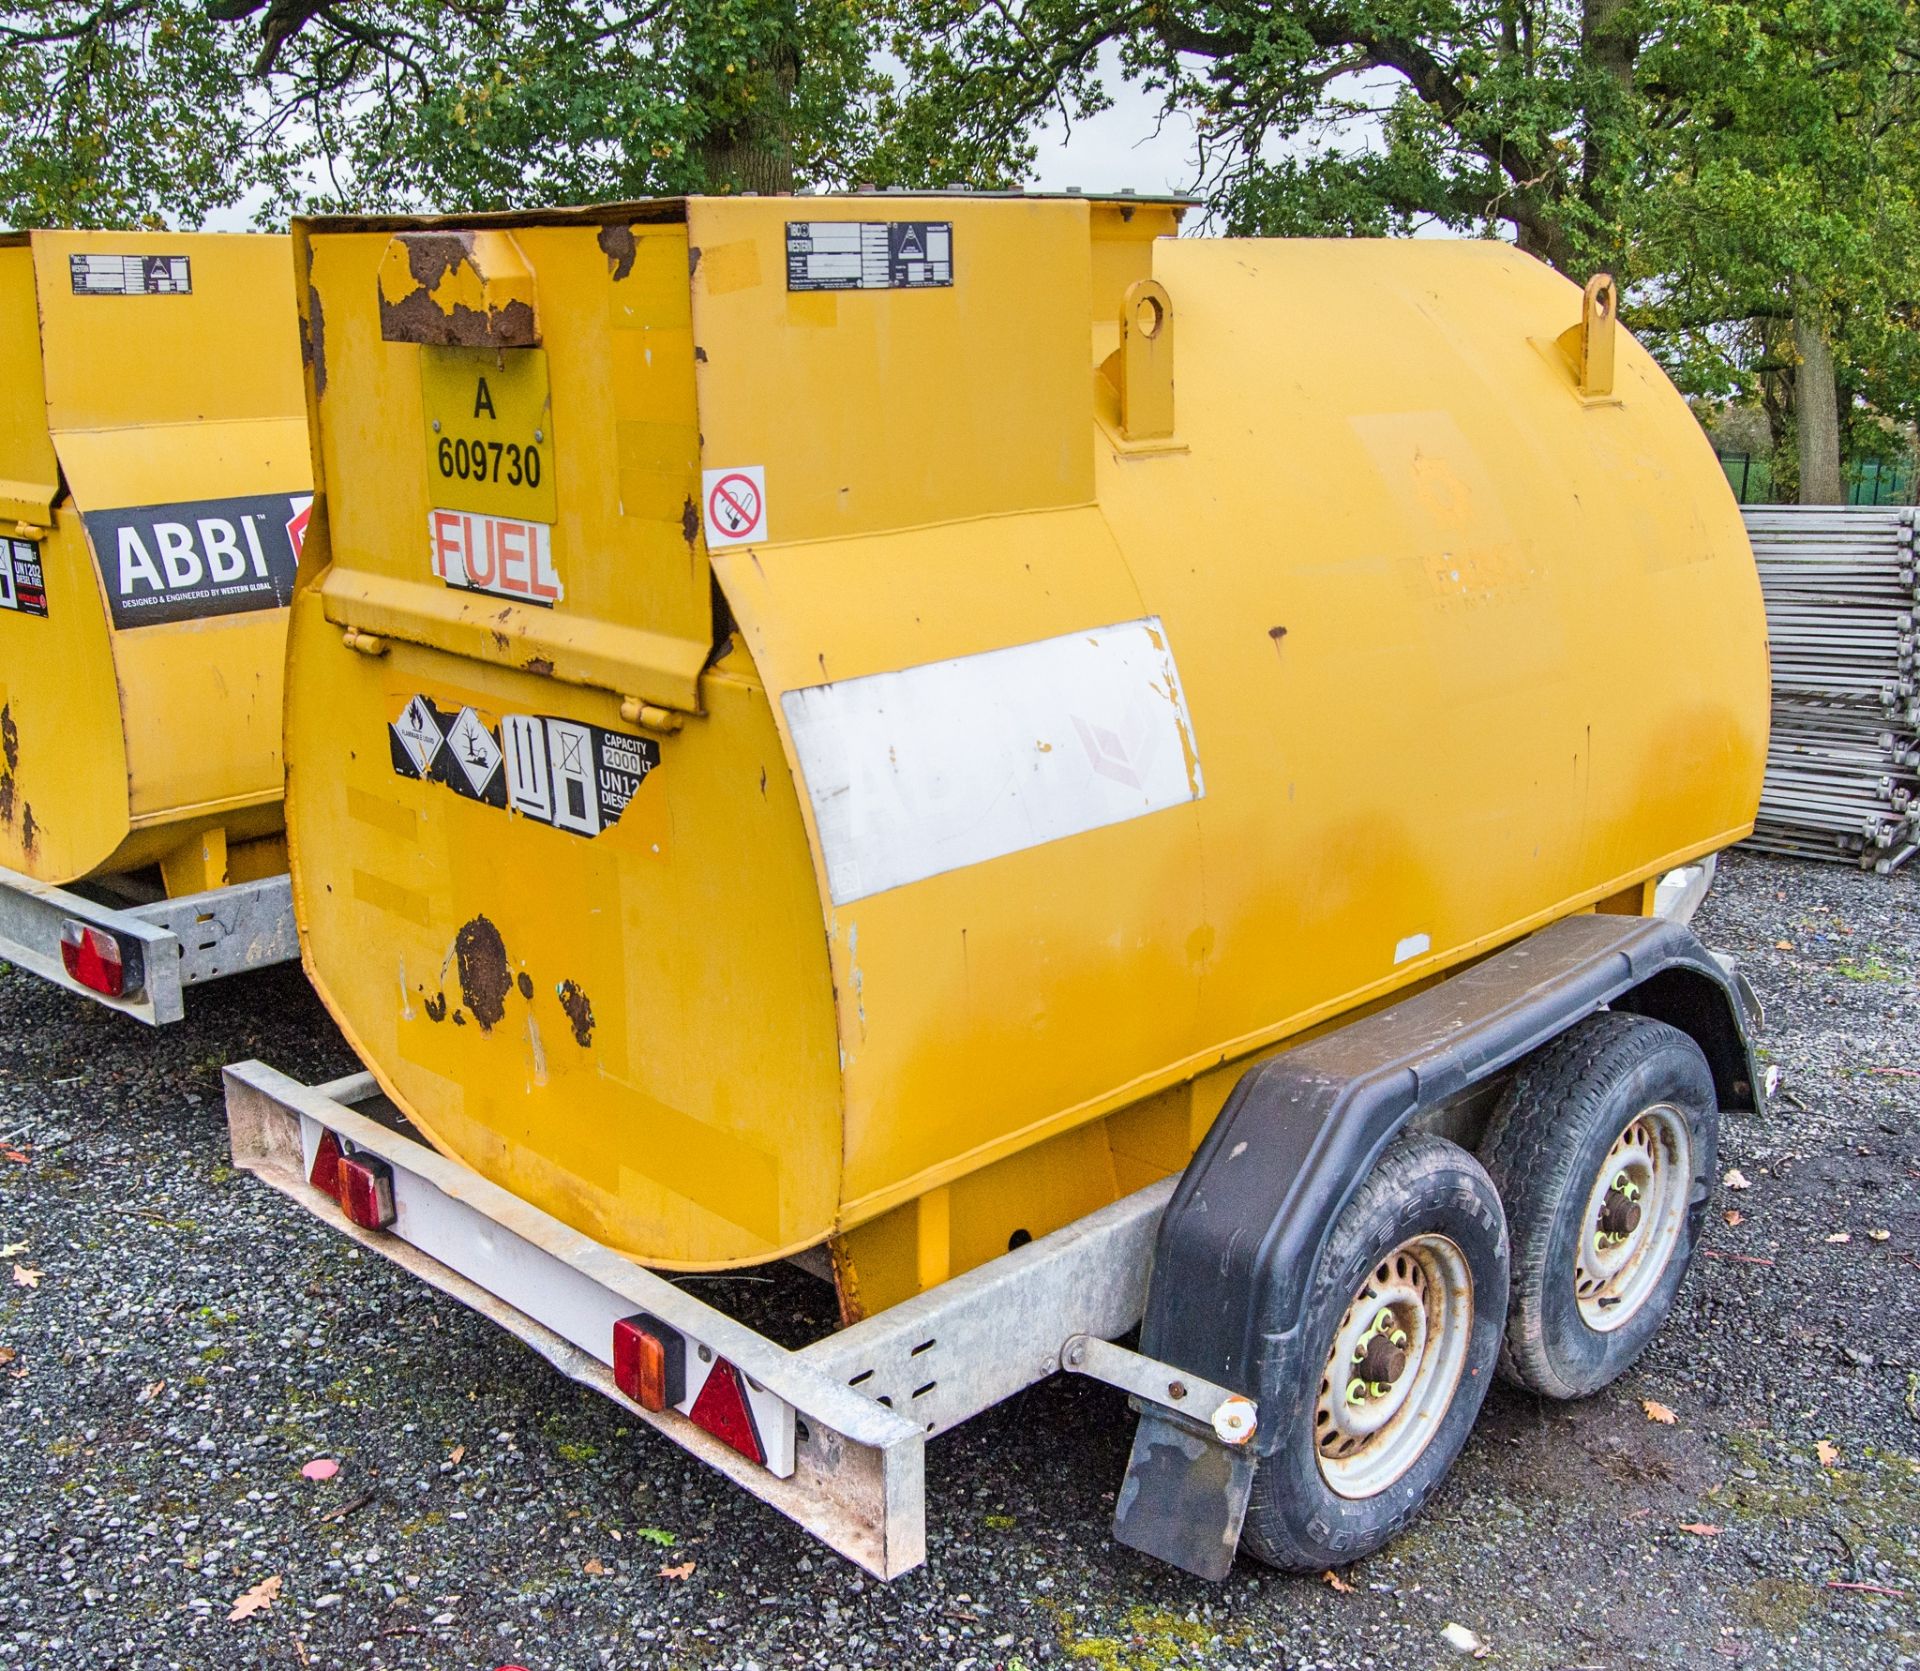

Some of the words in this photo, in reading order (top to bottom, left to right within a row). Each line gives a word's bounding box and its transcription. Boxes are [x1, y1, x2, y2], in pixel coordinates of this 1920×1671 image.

[474, 377, 496, 420] A
[438, 437, 541, 488] 609730
[117, 515, 268, 594] ABBI
[434, 512, 558, 598] FUEL
[14, 561, 42, 578] UN1202
[122, 596, 158, 609] DESIGNED
[160, 595, 166, 604] &
[166, 590, 210, 602] ENGINEERED
[211, 588, 220, 597] BY
[221, 584, 249, 595] WESTERN
[249, 581, 272, 591] GLOBAL
[604, 732, 647, 755] CAPACITY
[605, 749, 638, 772] 2000
[641, 760, 652, 773] LT
[601, 789, 632, 810] DIESE
